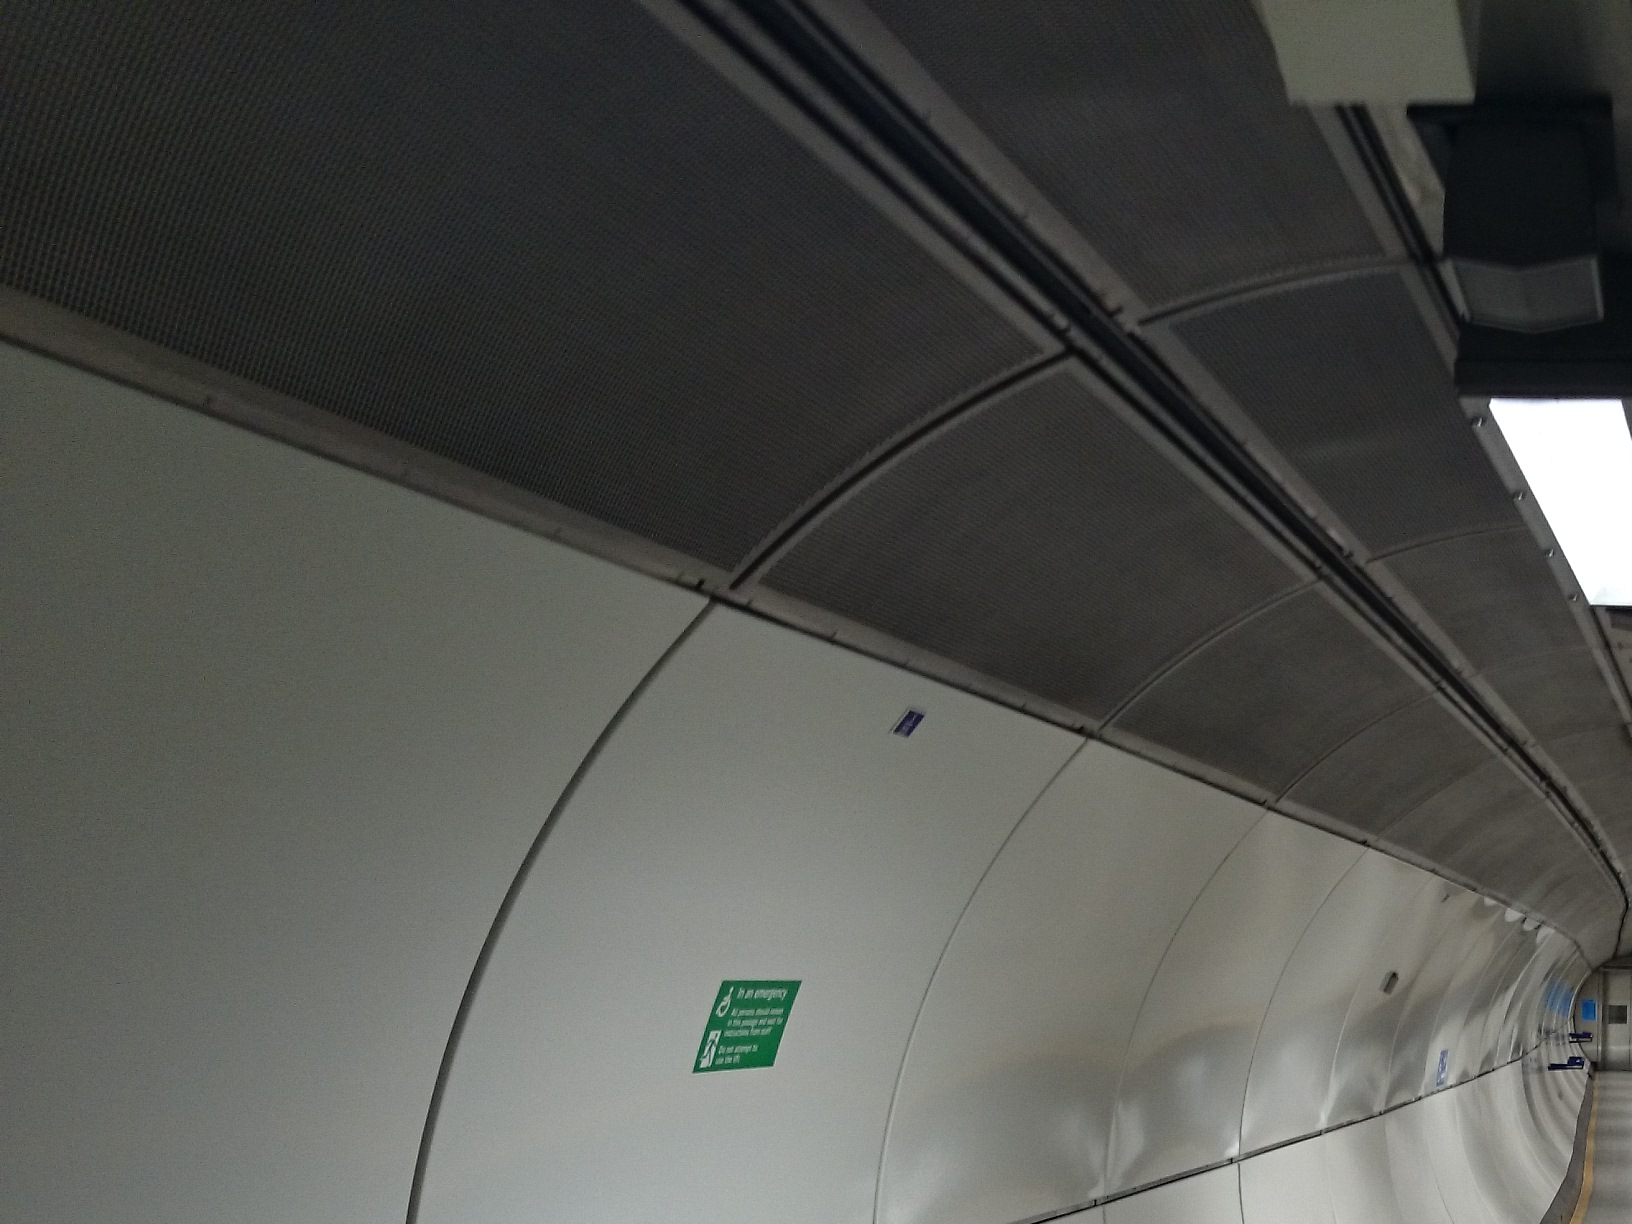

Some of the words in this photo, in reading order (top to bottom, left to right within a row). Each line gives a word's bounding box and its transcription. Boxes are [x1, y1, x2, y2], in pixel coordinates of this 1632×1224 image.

[737, 987, 745, 999] In
[745, 990, 754, 999] an
[754, 989, 788, 1000] emergency
